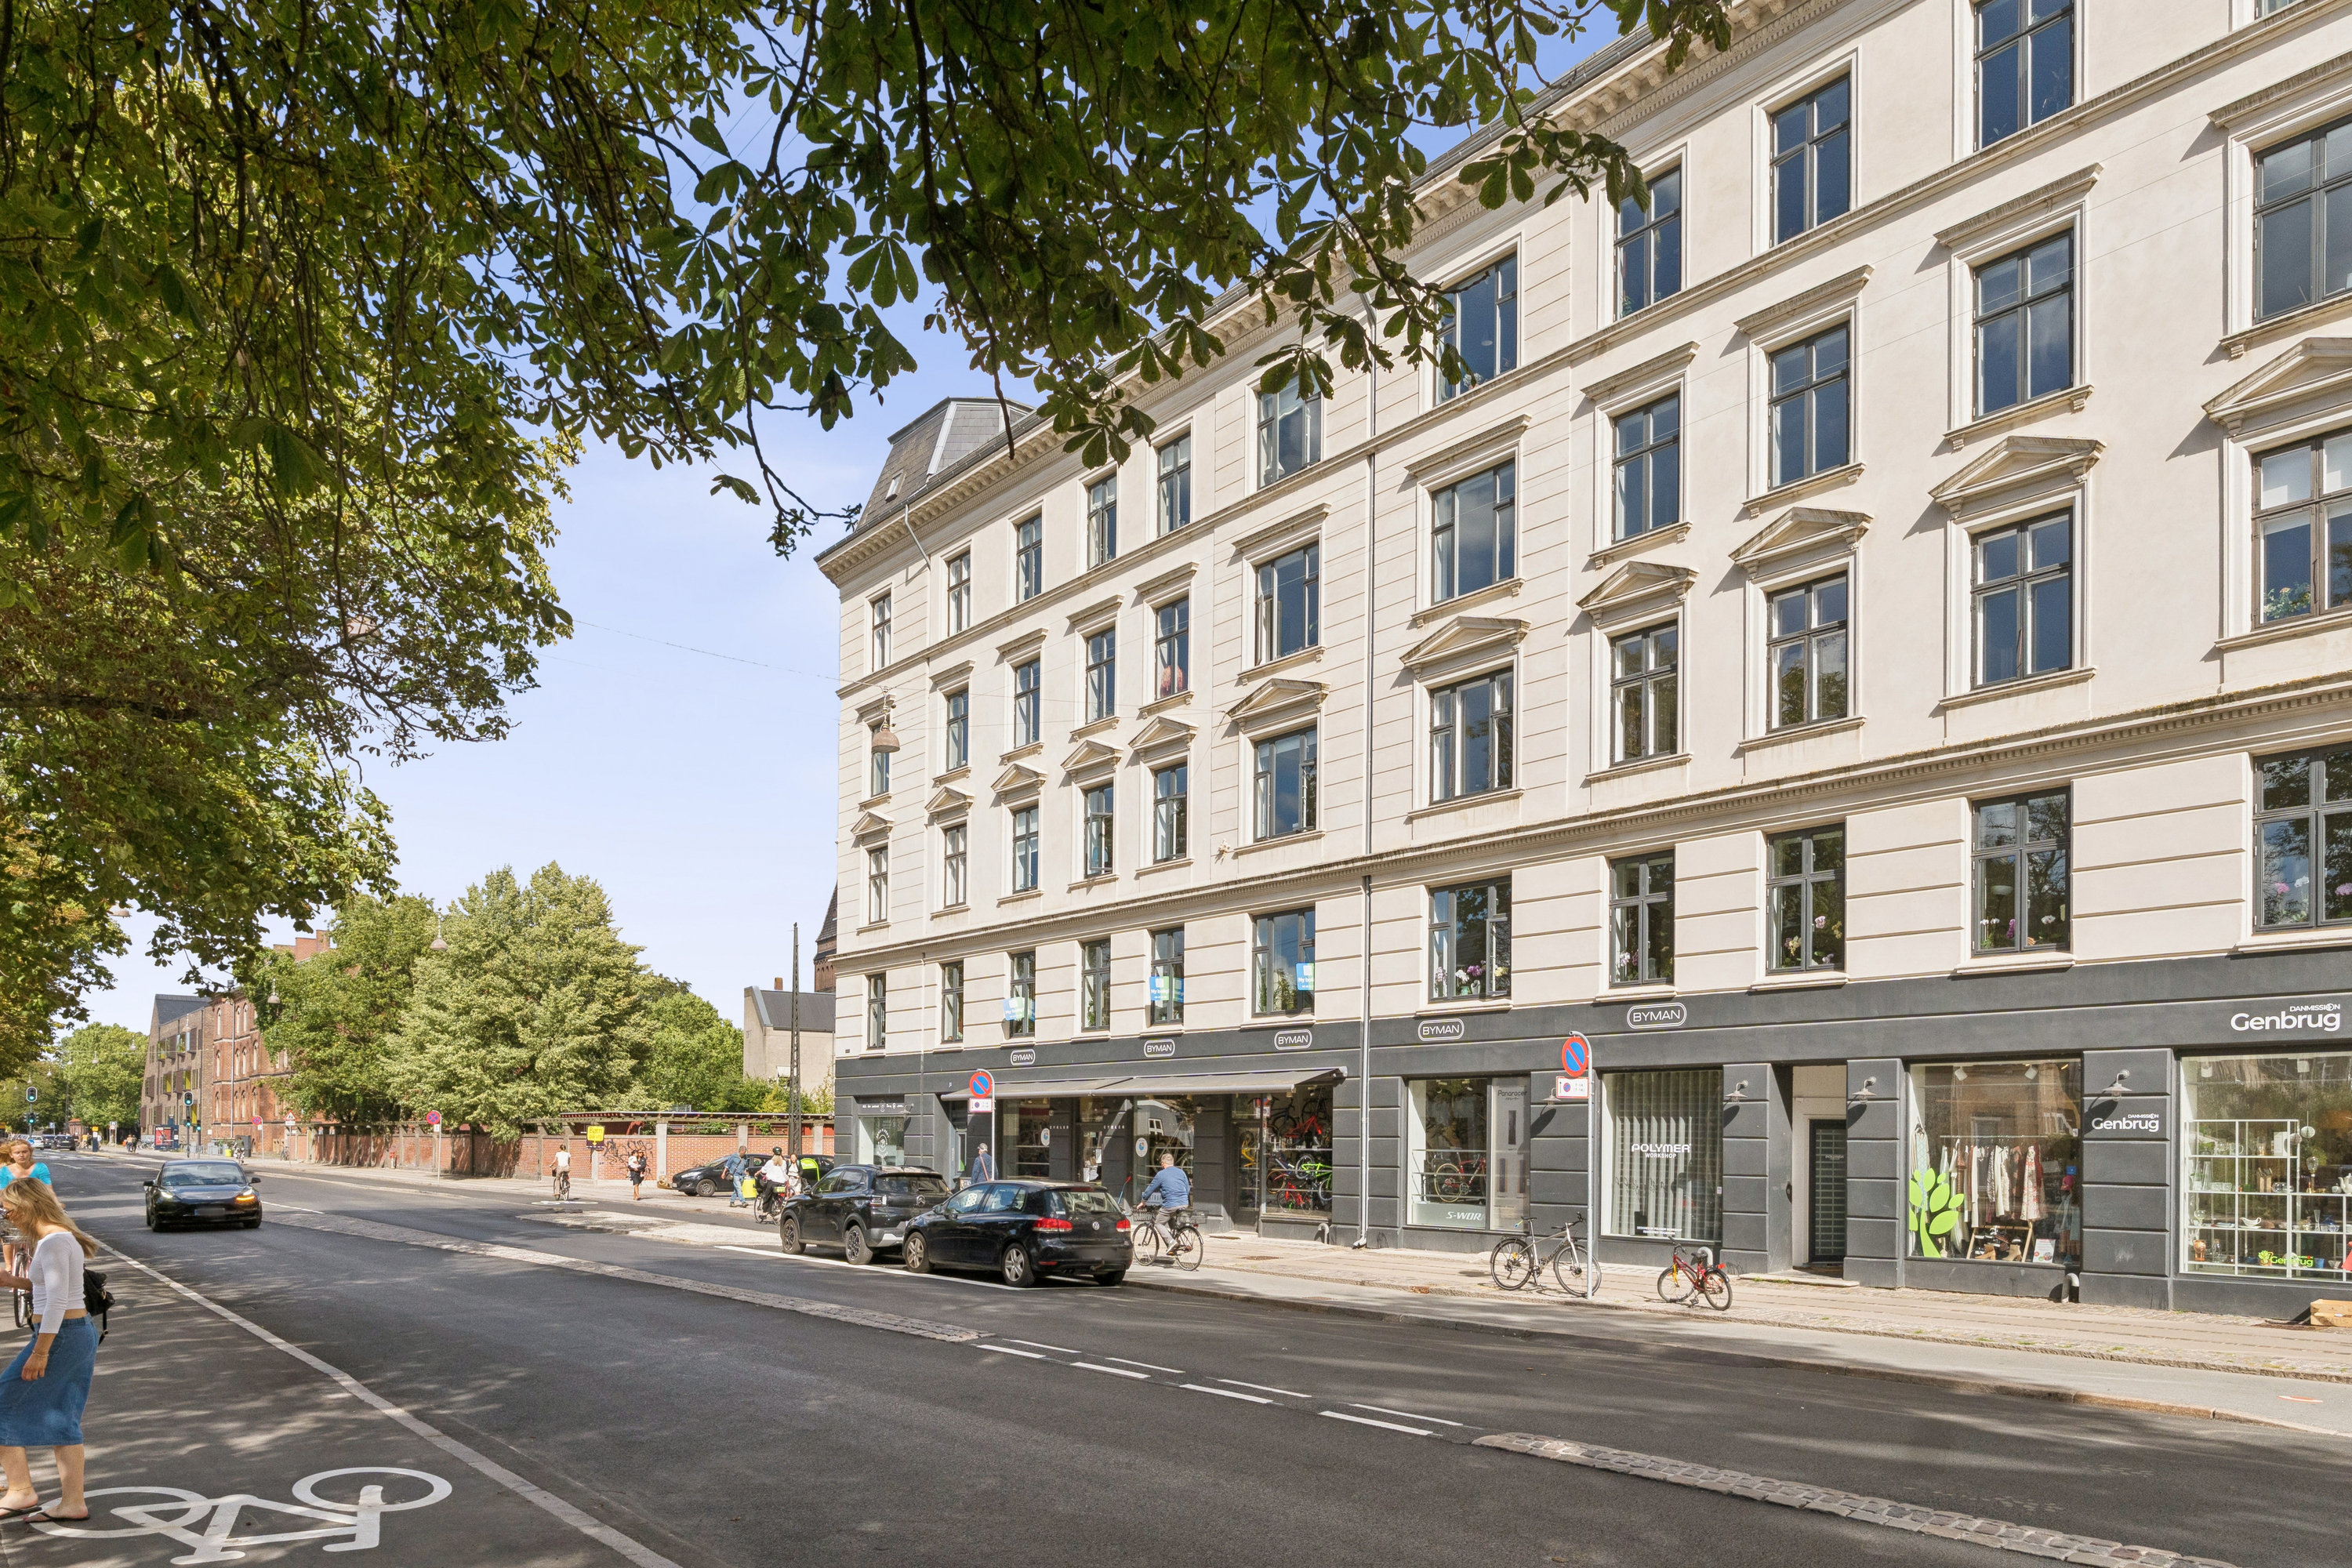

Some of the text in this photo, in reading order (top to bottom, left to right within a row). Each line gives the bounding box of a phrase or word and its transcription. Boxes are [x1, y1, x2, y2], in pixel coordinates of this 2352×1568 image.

[2289, 1003, 2340, 1012] DANMISSION
[1633, 1009, 1680, 1022] BYMAN
[2230, 1011, 2340, 1032] Genbrug
[1422, 1024, 1460, 1036] BYMAN
[1278, 1035, 1308, 1044] BYMAN
[1147, 1044, 1172, 1053] BYMAN
[2092, 1116, 2159, 1133] Genbrug
[1631, 1143, 1690, 1153] POLYMER
